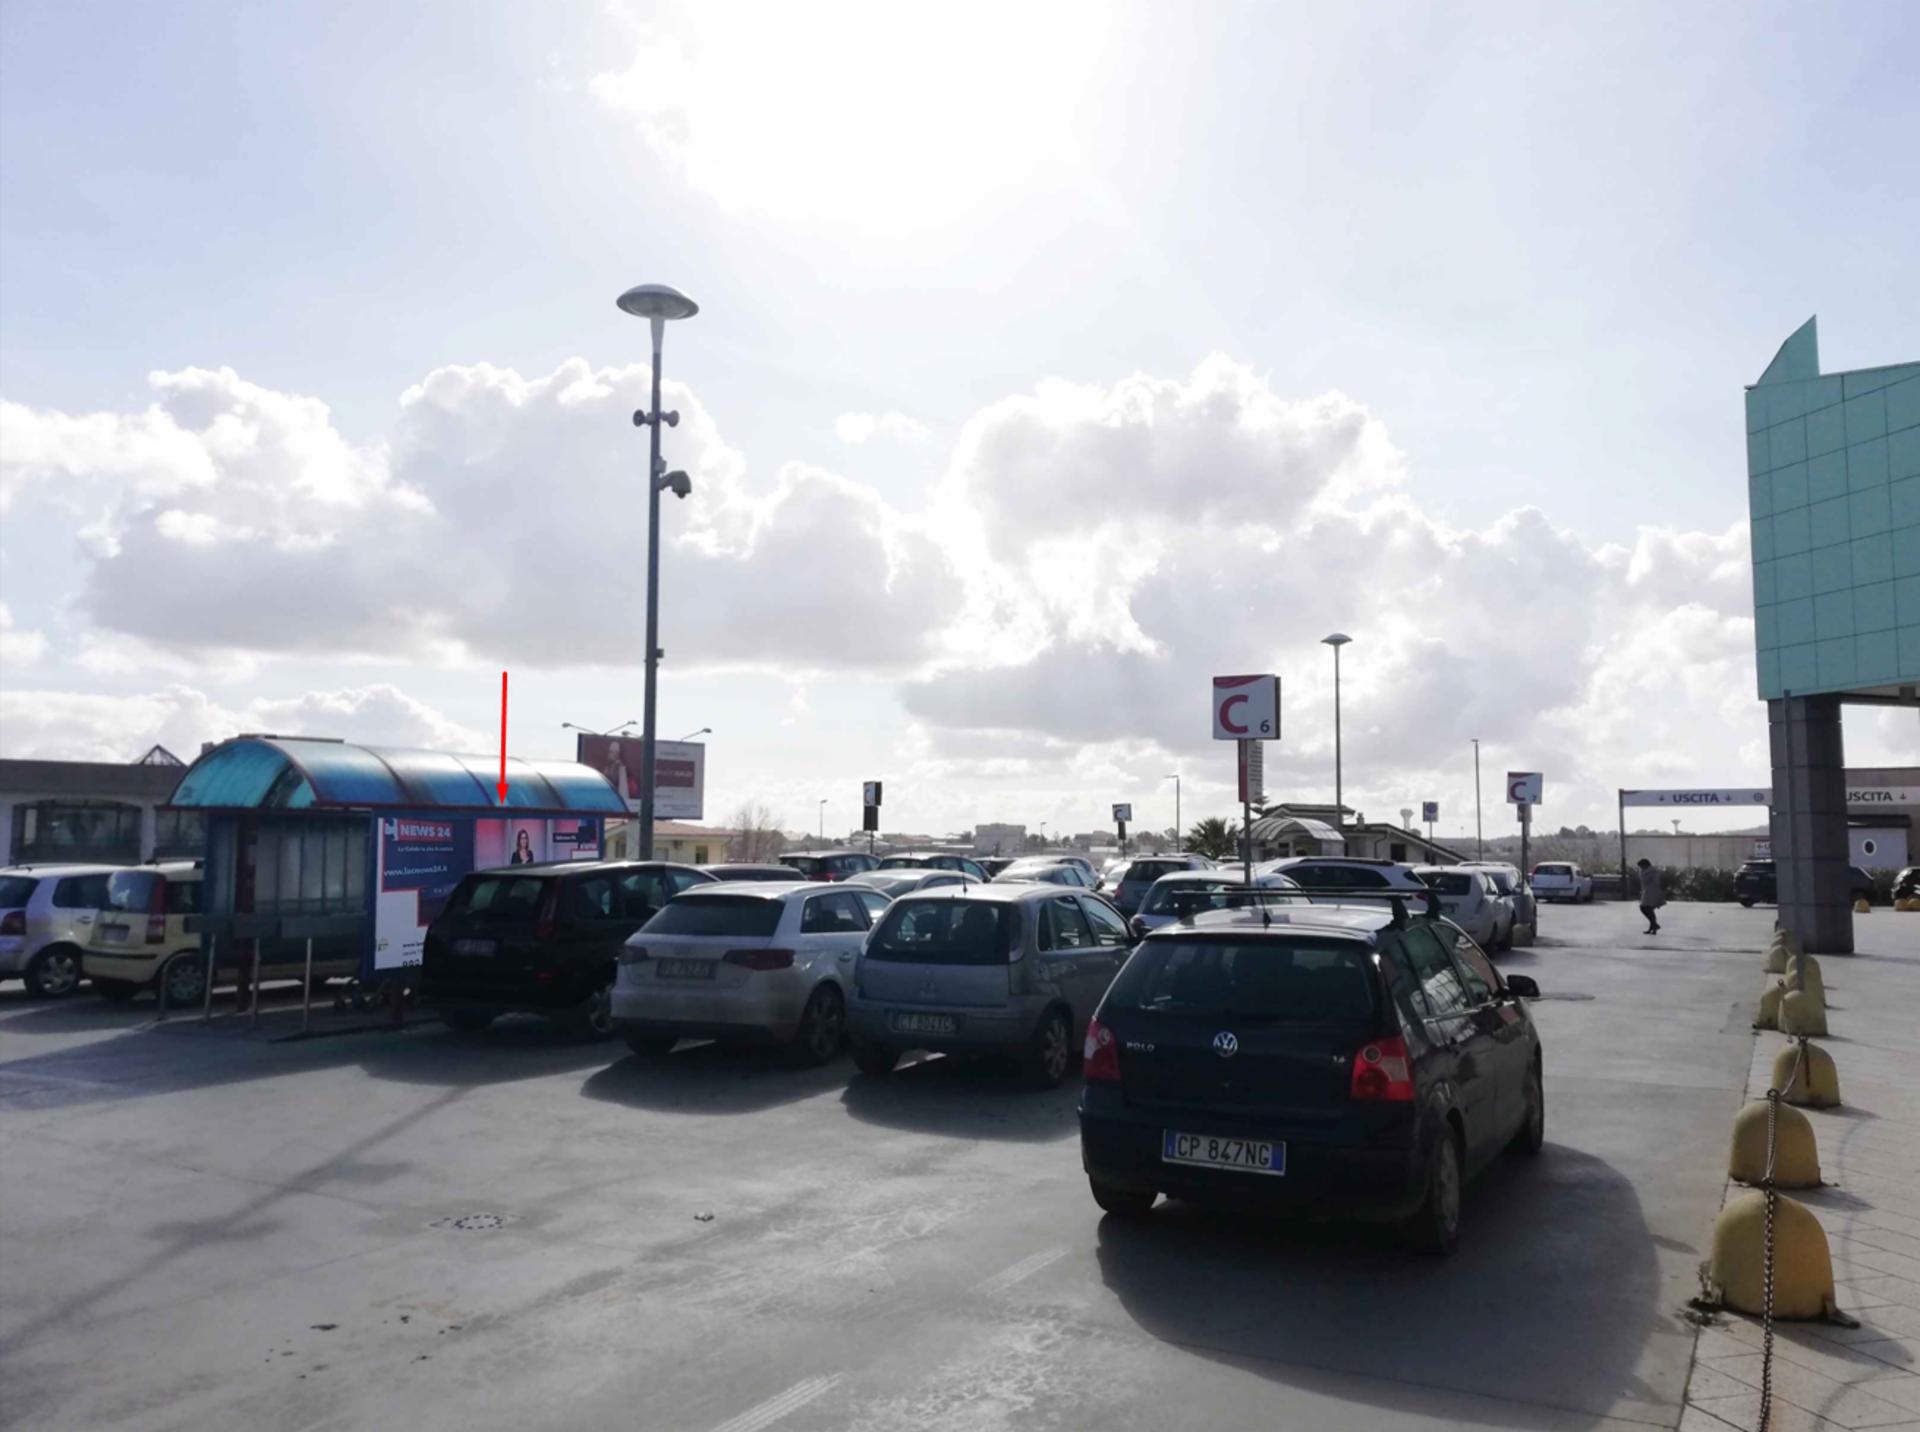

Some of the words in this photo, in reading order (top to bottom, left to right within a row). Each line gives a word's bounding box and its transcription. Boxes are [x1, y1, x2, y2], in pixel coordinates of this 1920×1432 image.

[1219, 694, 1249, 734] C
[1259, 719, 1270, 733] 6
[1510, 781, 1527, 801] C
[1672, 793, 1719, 803] USCITA
[400, 824, 435, 837] NEWS
[437, 827, 452, 837] 24
[1126, 1041, 1154, 1051] POLO
[1178, 1136, 1200, 1157] CP
[1208, 1139, 1270, 1166] 847NG
